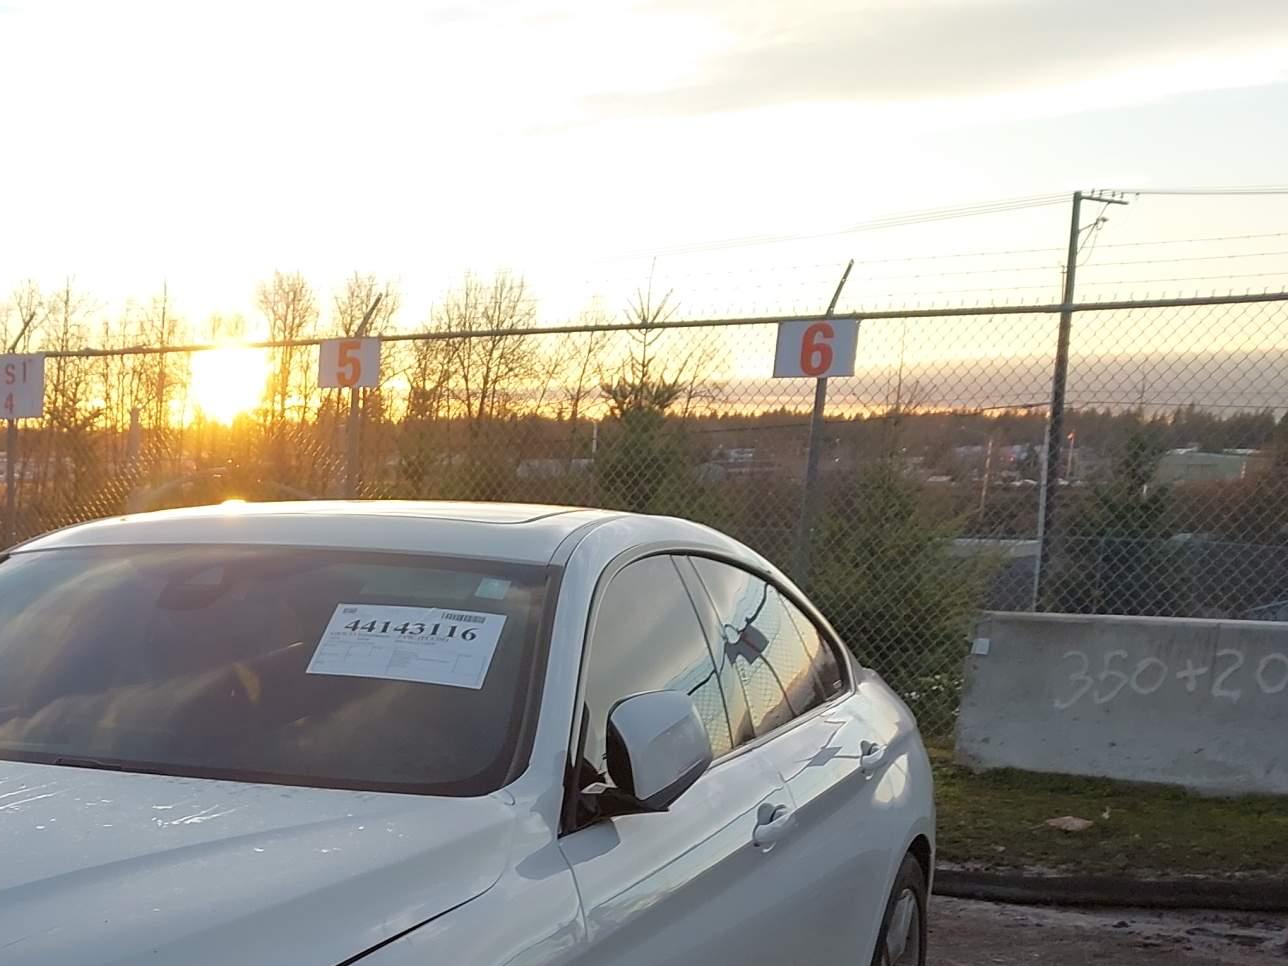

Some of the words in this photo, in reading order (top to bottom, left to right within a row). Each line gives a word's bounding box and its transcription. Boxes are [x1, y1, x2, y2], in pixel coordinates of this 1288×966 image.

[336, 340, 361, 386] 5
[800, 321, 835, 376] 6
[4, 391, 15, 414] 4
[344, 619, 481, 642] 44143116
